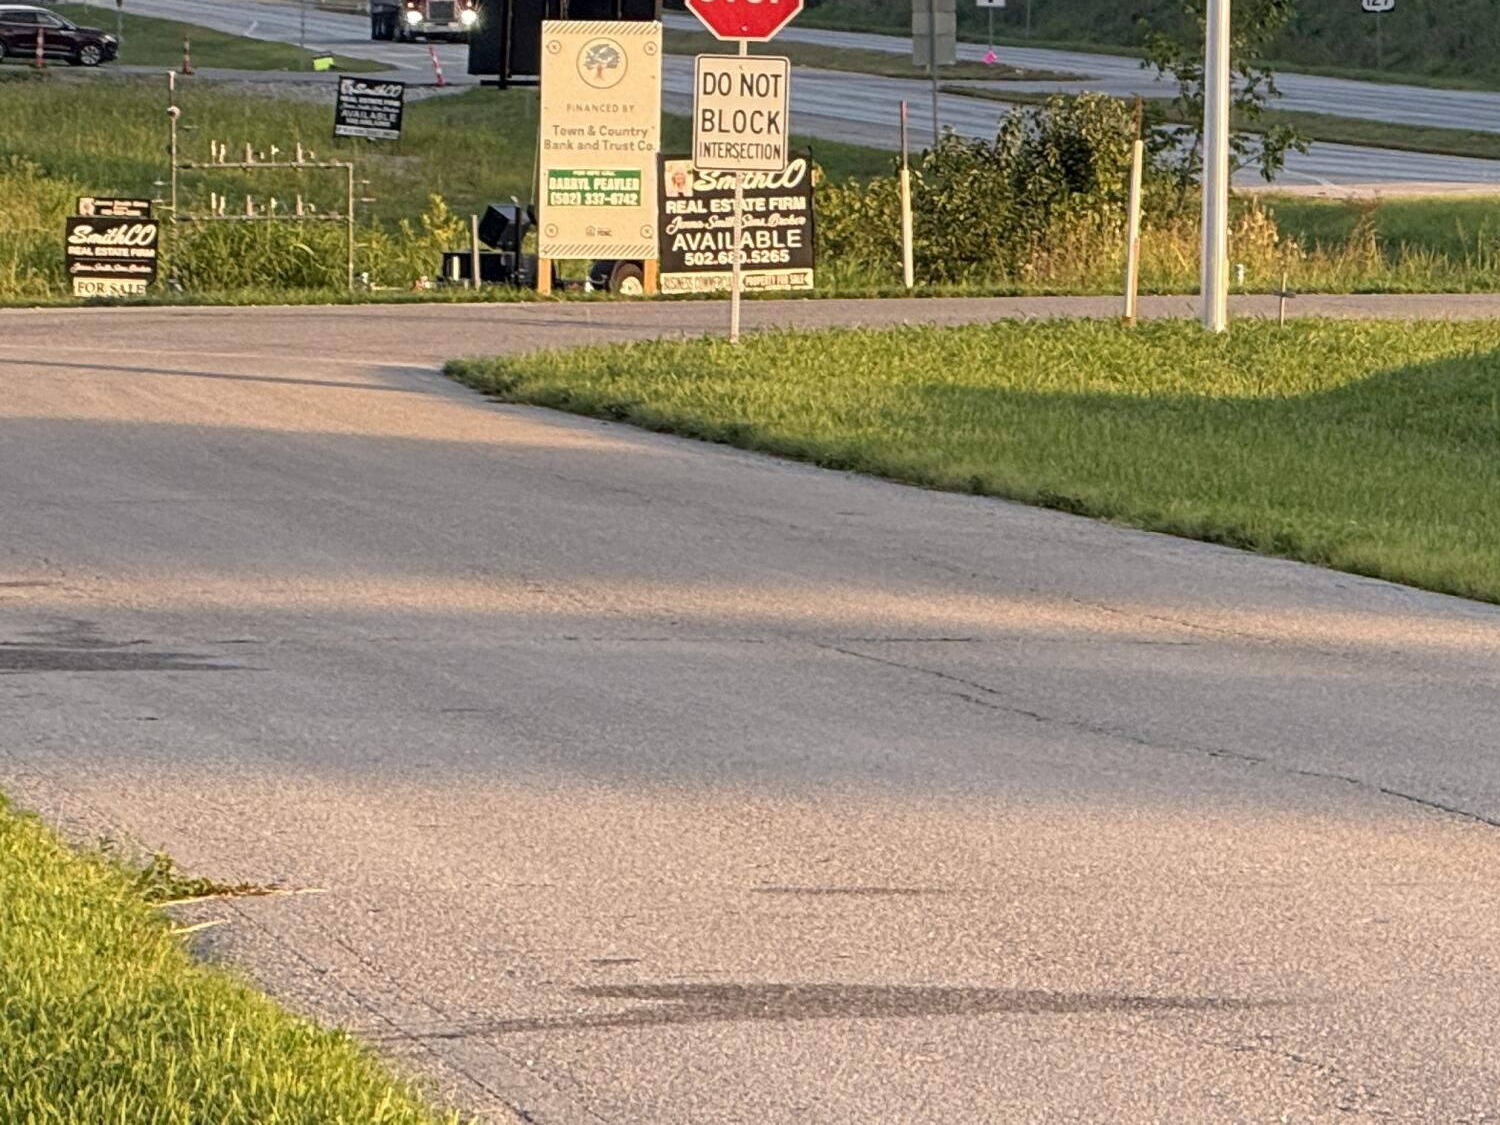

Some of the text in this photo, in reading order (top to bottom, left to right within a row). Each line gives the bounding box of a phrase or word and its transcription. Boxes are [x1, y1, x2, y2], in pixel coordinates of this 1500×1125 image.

[703, 71, 783, 99] DO NOT
[566, 103, 636, 113] FINANCED BY
[701, 108, 781, 136] BLOCK
[552, 124, 649, 138] Town & Country
[543, 138, 574, 150] Bank
[577, 138, 600, 150] and
[602, 138, 635, 150] Trust
[698, 141, 782, 161] INTERSECTION
[593, 177, 640, 191] PEAVLER
[550, 191, 582, 205] (502)
[665, 196, 806, 214] REAL ESTATE FIRM
[67, 224, 157, 246] SmithCO
[671, 229, 802, 252] AVAILABLE
[77, 281, 146, 295] FOR SALE
